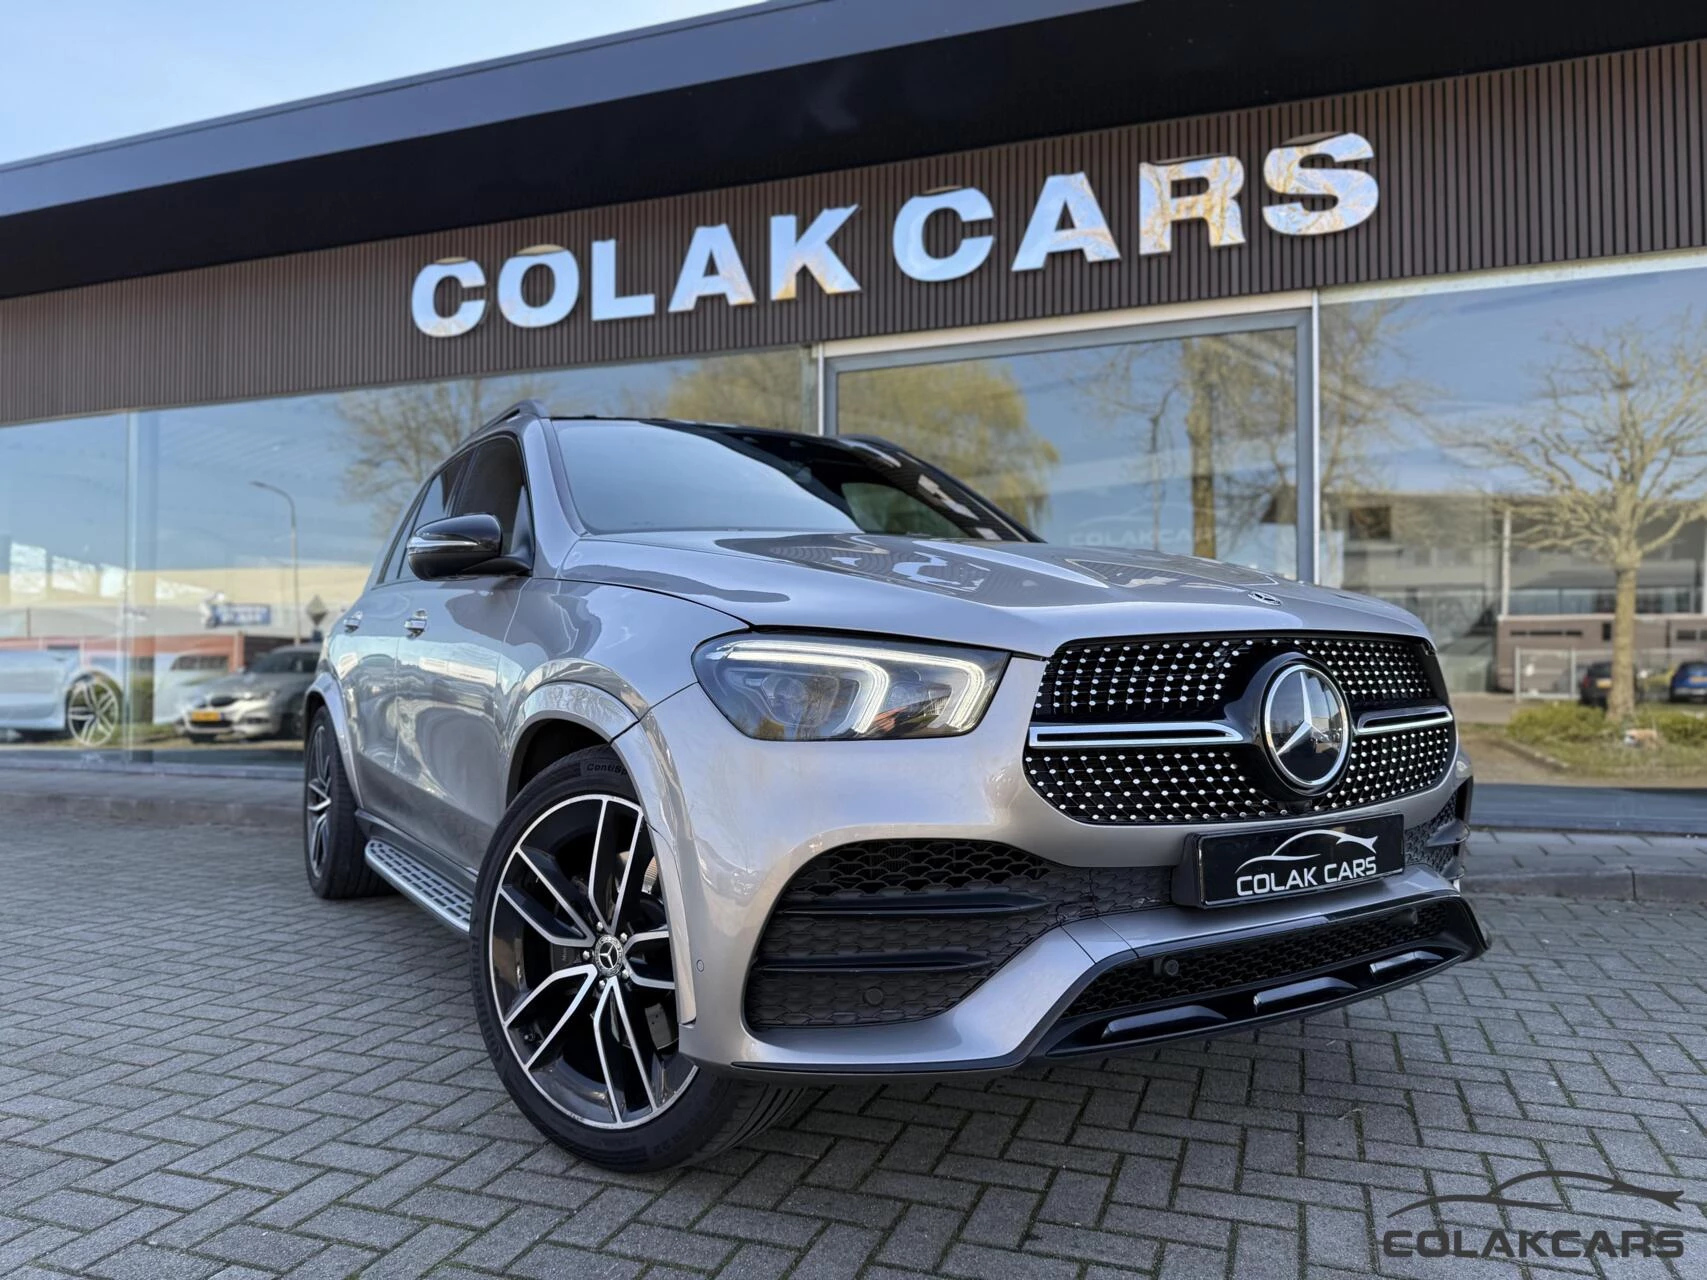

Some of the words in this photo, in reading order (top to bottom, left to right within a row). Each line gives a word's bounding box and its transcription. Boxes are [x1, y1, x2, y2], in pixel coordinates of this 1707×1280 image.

[411, 203, 862, 339] COLAK
[893, 131, 1379, 282] CARS
[1069, 528, 1215, 547] COLAKCA
[1236, 867, 1317, 896] COLAK
[1324, 856, 1377, 883] CARS
